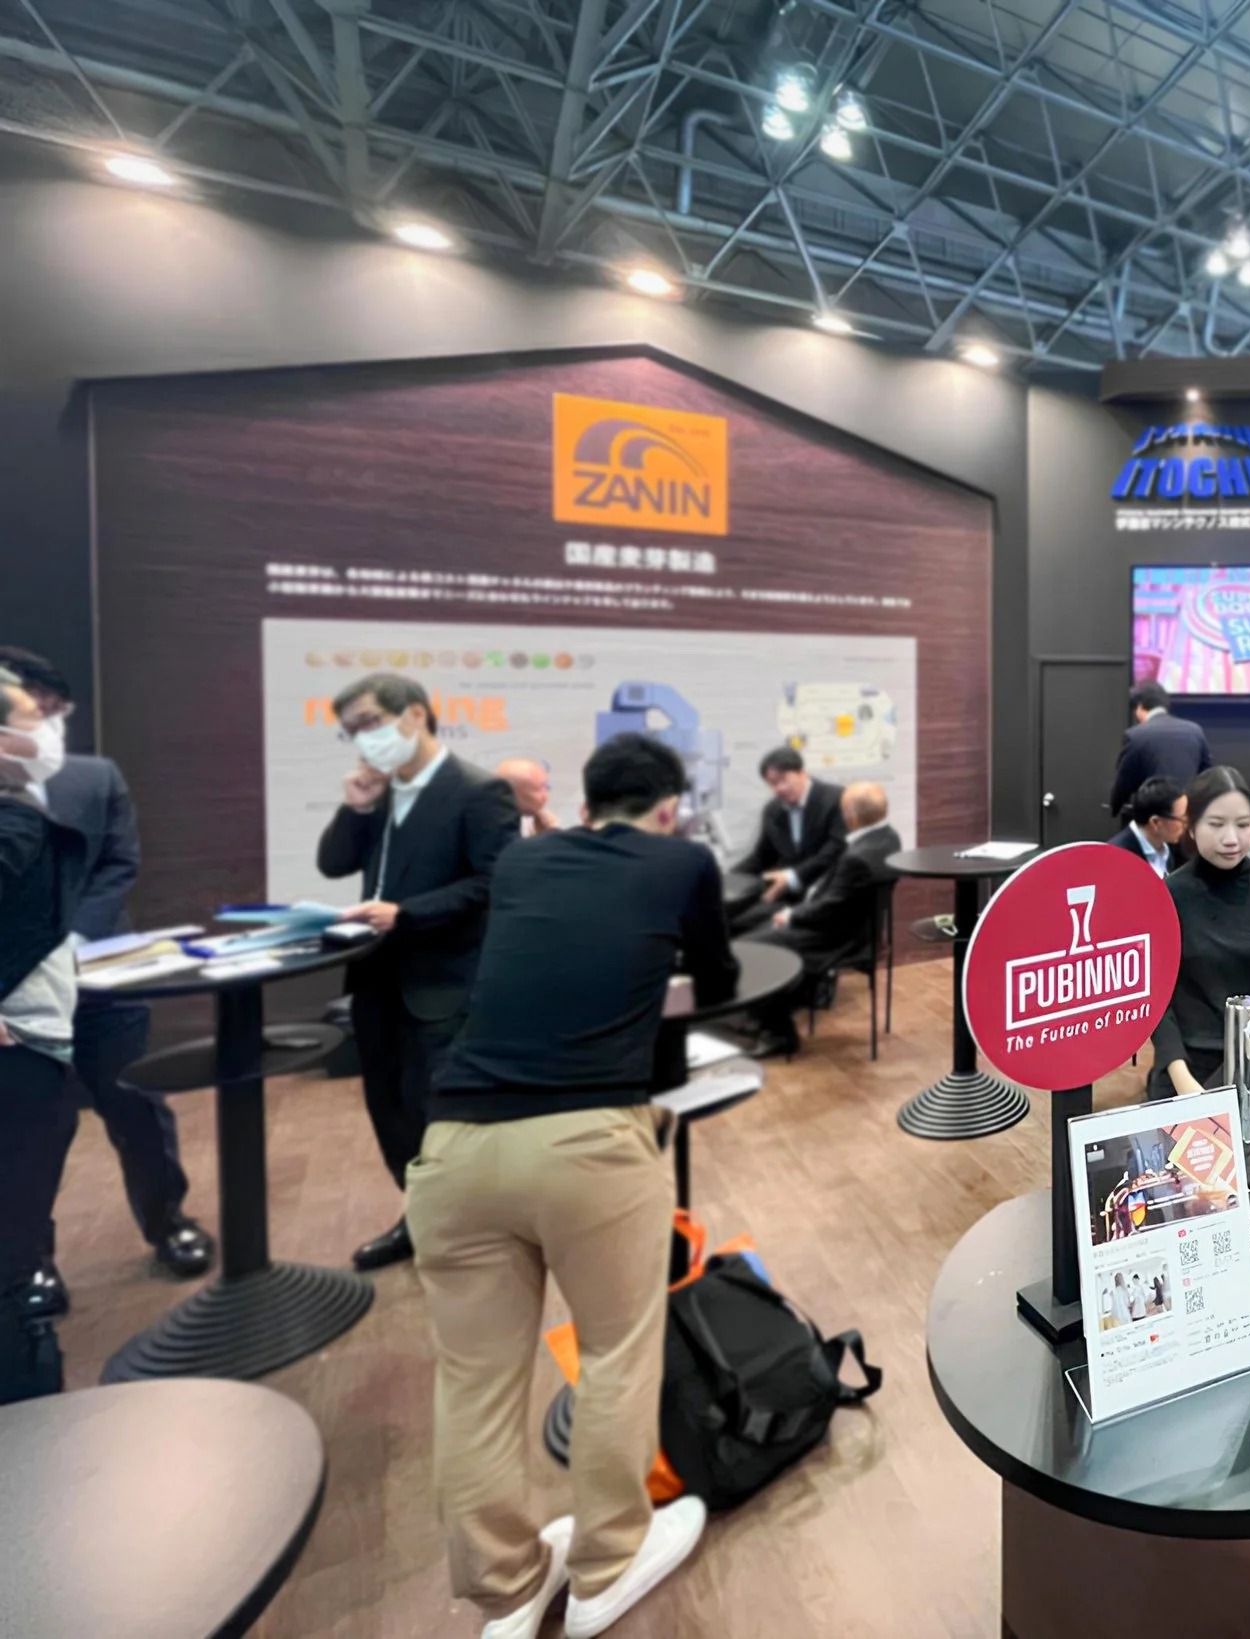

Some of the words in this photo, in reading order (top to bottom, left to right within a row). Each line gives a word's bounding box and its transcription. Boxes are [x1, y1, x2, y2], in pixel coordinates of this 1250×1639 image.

[573, 469, 711, 518] ZANIN
[1018, 948, 1140, 1014] PUBINNO
[1006, 1034, 1034, 1054] The
[1040, 1021, 1089, 1045] Future
[1095, 1010, 1111, 1030] of
[1115, 1003, 1150, 1025] Draft
